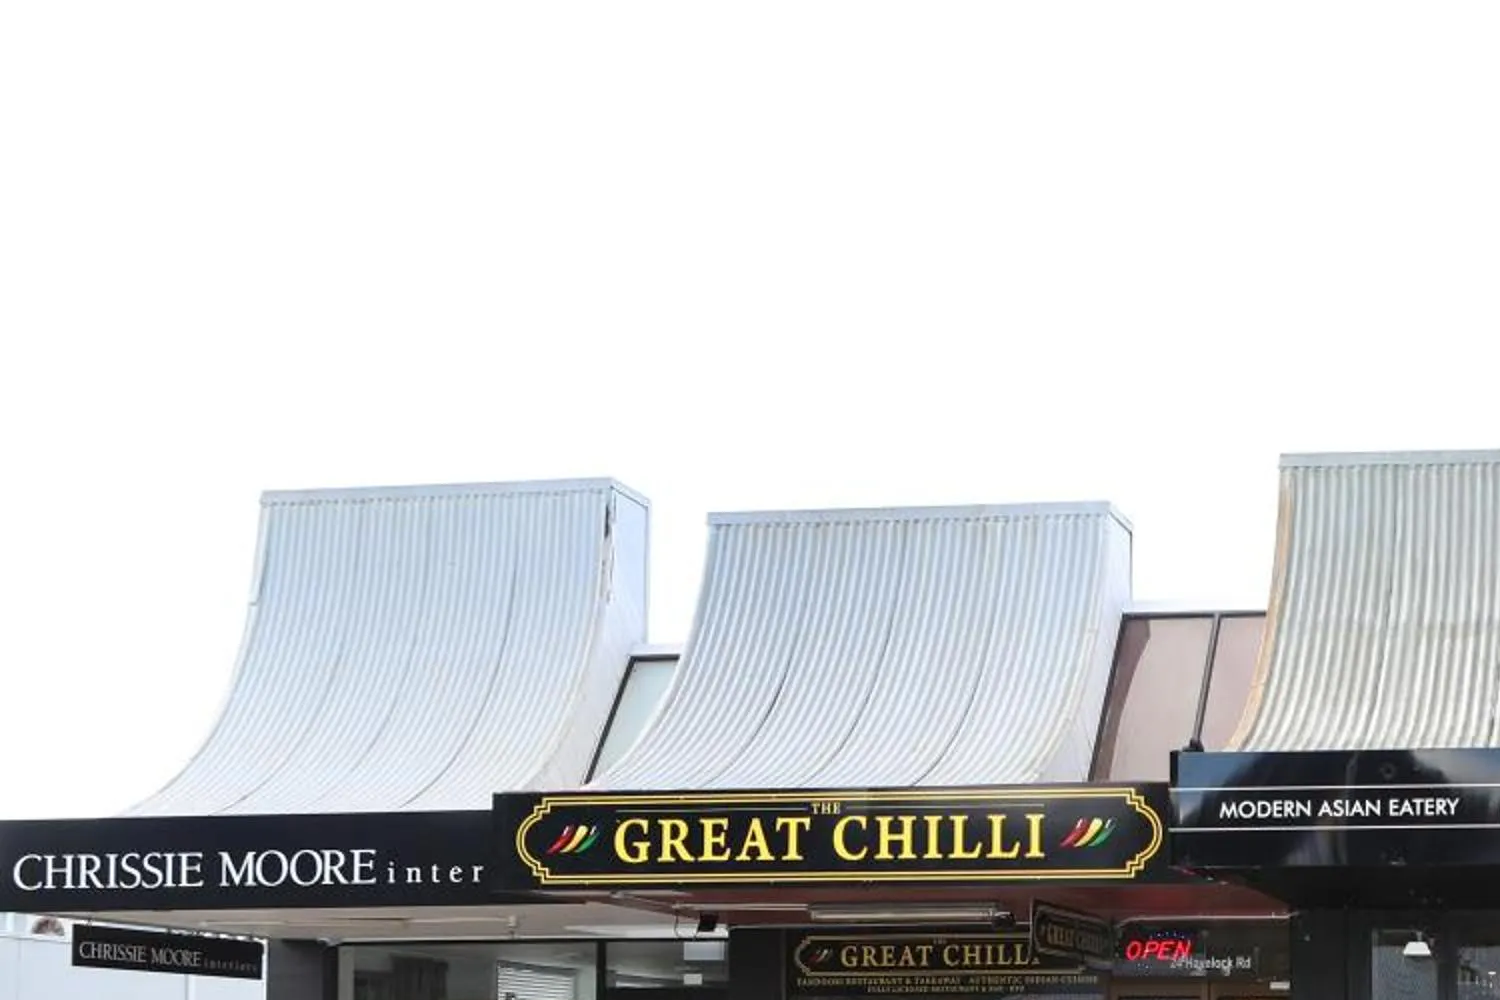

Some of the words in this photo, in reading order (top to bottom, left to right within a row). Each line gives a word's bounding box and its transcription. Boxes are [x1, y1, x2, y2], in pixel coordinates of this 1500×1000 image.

[811, 802, 842, 815] THE
[1218, 801, 1312, 820] MODERN
[1317, 799, 1382, 818] ASIAN
[1388, 798, 1460, 817] EATERY
[613, 816, 811, 864] GREAT
[832, 813, 1046, 861] CHILLI
[13, 852, 205, 890] CHRISSIE
[218, 849, 377, 887] MOORE
[387, 861, 485, 884] inter
[78, 940, 148, 964] CHRISSIE
[150, 948, 204, 968] MOORE
[840, 945, 933, 968] GREAT
[943, 942, 1041, 967] CHILL
[1125, 939, 1192, 961] OPEN
[1235, 955, 1252, 969] Rd
